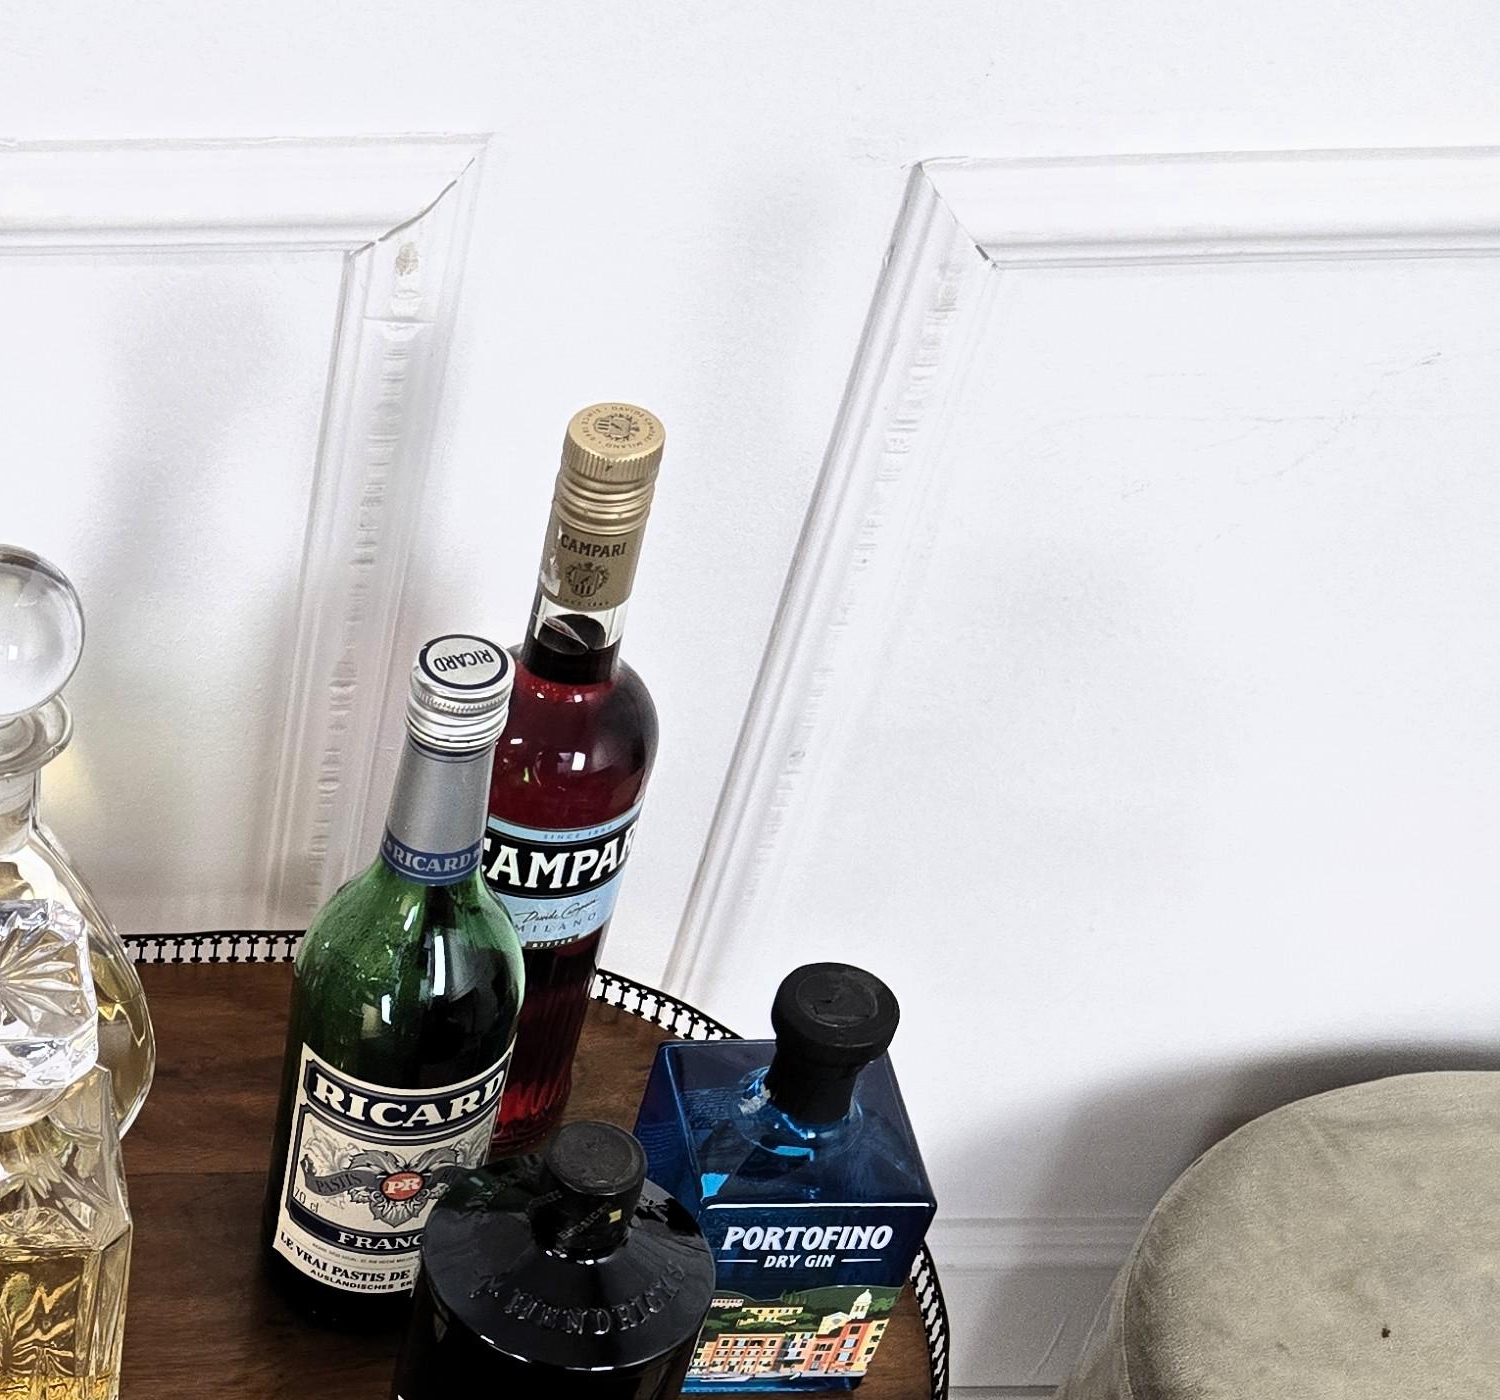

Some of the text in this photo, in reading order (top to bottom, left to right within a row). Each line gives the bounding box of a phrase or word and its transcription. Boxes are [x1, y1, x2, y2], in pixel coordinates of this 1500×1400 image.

[560, 533, 627, 558] CAMPARI
[433, 648, 495, 672] RICARD
[392, 844, 471, 872] RICARD
[483, 820, 638, 889] AMPAR
[515, 912, 596, 932] MILANO
[313, 1069, 505, 1128] RICARD
[315, 1172, 363, 1193] PASTIS
[385, 1177, 424, 1194] PR
[294, 1186, 307, 1205] 70
[338, 1231, 423, 1250] FRANC
[721, 1225, 894, 1250] PORTOFINO
[280, 1231, 294, 1250] LE
[295, 1244, 327, 1271] VRAI
[332, 1265, 386, 1282] PASTIS
[389, 1269, 410, 1281] DE
[763, 1254, 836, 1268] DRY GIN
